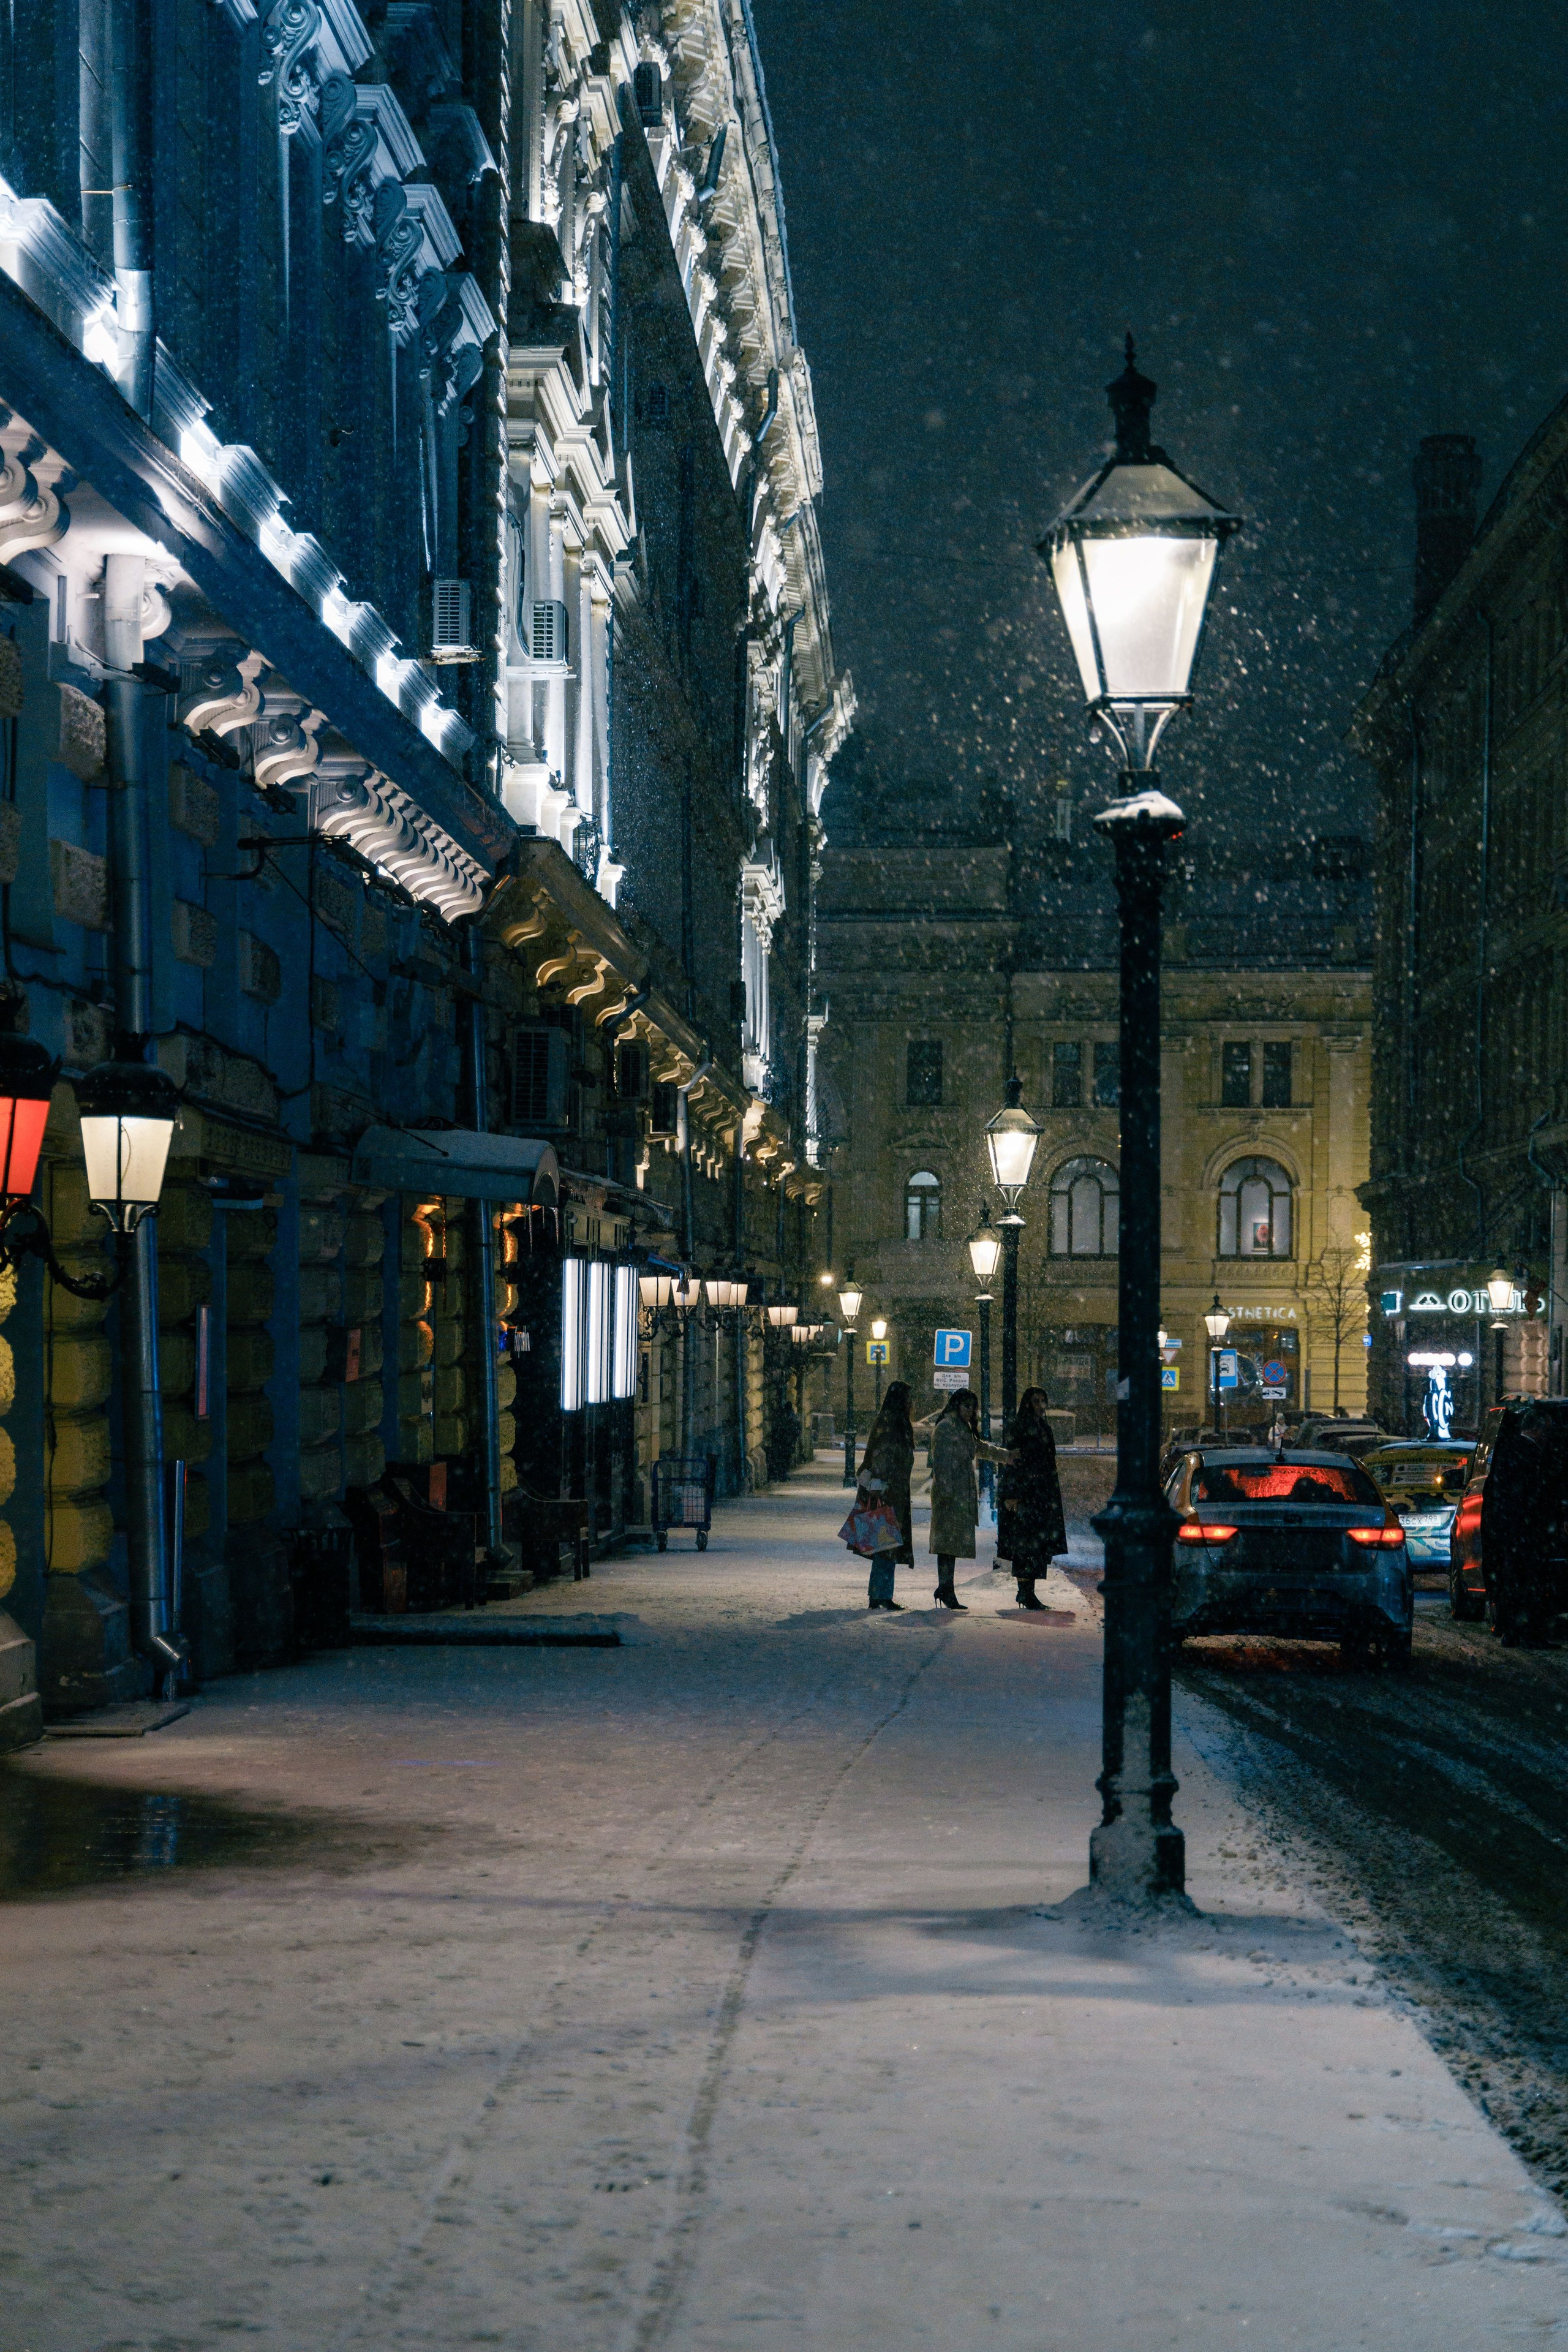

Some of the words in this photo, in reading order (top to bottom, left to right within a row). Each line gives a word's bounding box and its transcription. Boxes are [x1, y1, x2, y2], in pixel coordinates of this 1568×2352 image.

[1449, 1290, 1545, 1312] ОТЛ
[1223, 1306, 1296, 1319] STHETICA
[945, 1335, 964, 1362] P
